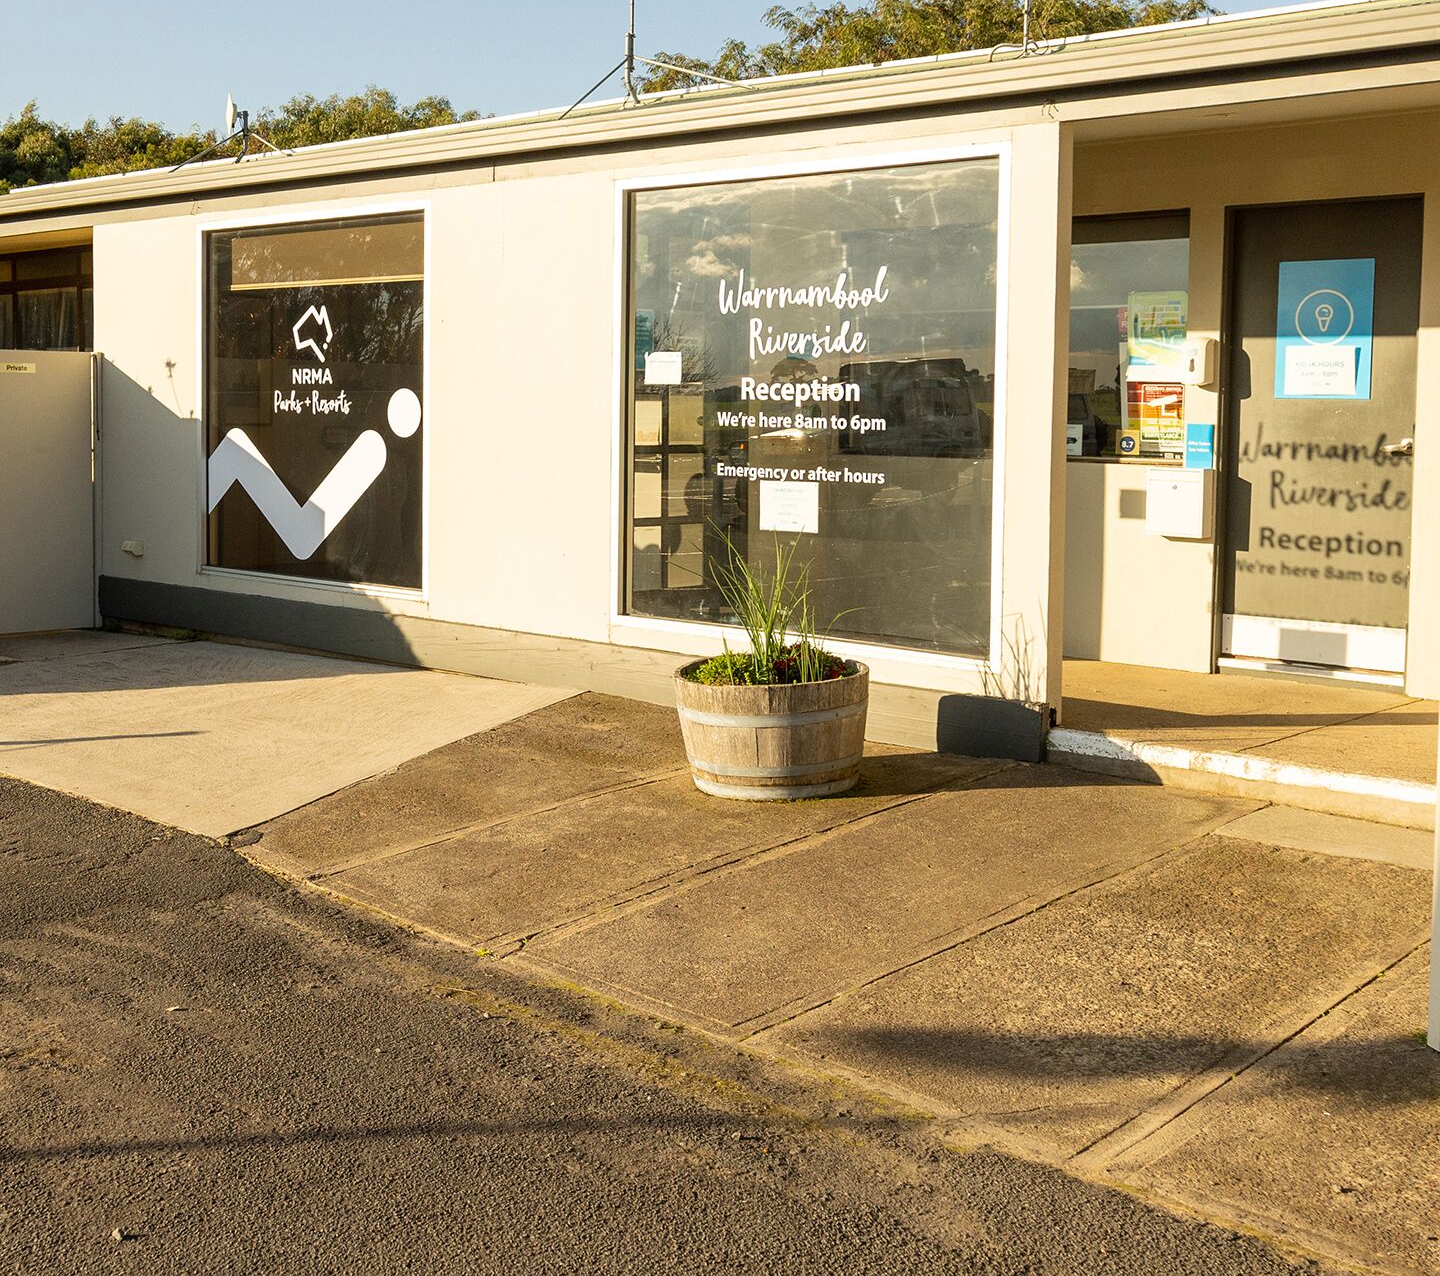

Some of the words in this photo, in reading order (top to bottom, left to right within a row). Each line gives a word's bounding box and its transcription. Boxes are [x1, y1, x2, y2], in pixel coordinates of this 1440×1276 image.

[718, 265, 889, 315] Warrnambool
[749, 317, 867, 360] Riverside
[6, 364, 28, 372] Private
[292, 367, 333, 385] NRMA
[1318, 360, 1345, 368] HOURS
[273, 389, 304, 414] Parks
[311, 389, 353, 416] Resorts
[740, 376, 861, 408] Reception
[759, 412, 793, 429] here
[794, 413, 828, 430] 8am
[830, 416, 849, 431] to
[850, 415, 887, 435] 6pm
[1121, 440, 1134, 449] 8.7
[716, 462, 788, 482] Emergency
[790, 469, 806, 480] or
[807, 466, 842, 482] after
[843, 467, 886, 484] hours
[1270, 469, 1410, 513] Riverside
[1259, 526, 1404, 559] Reception
[1279, 561, 1320, 578] here
[1323, 565, 1364, 582] 8am
[1367, 568, 1389, 585] to
